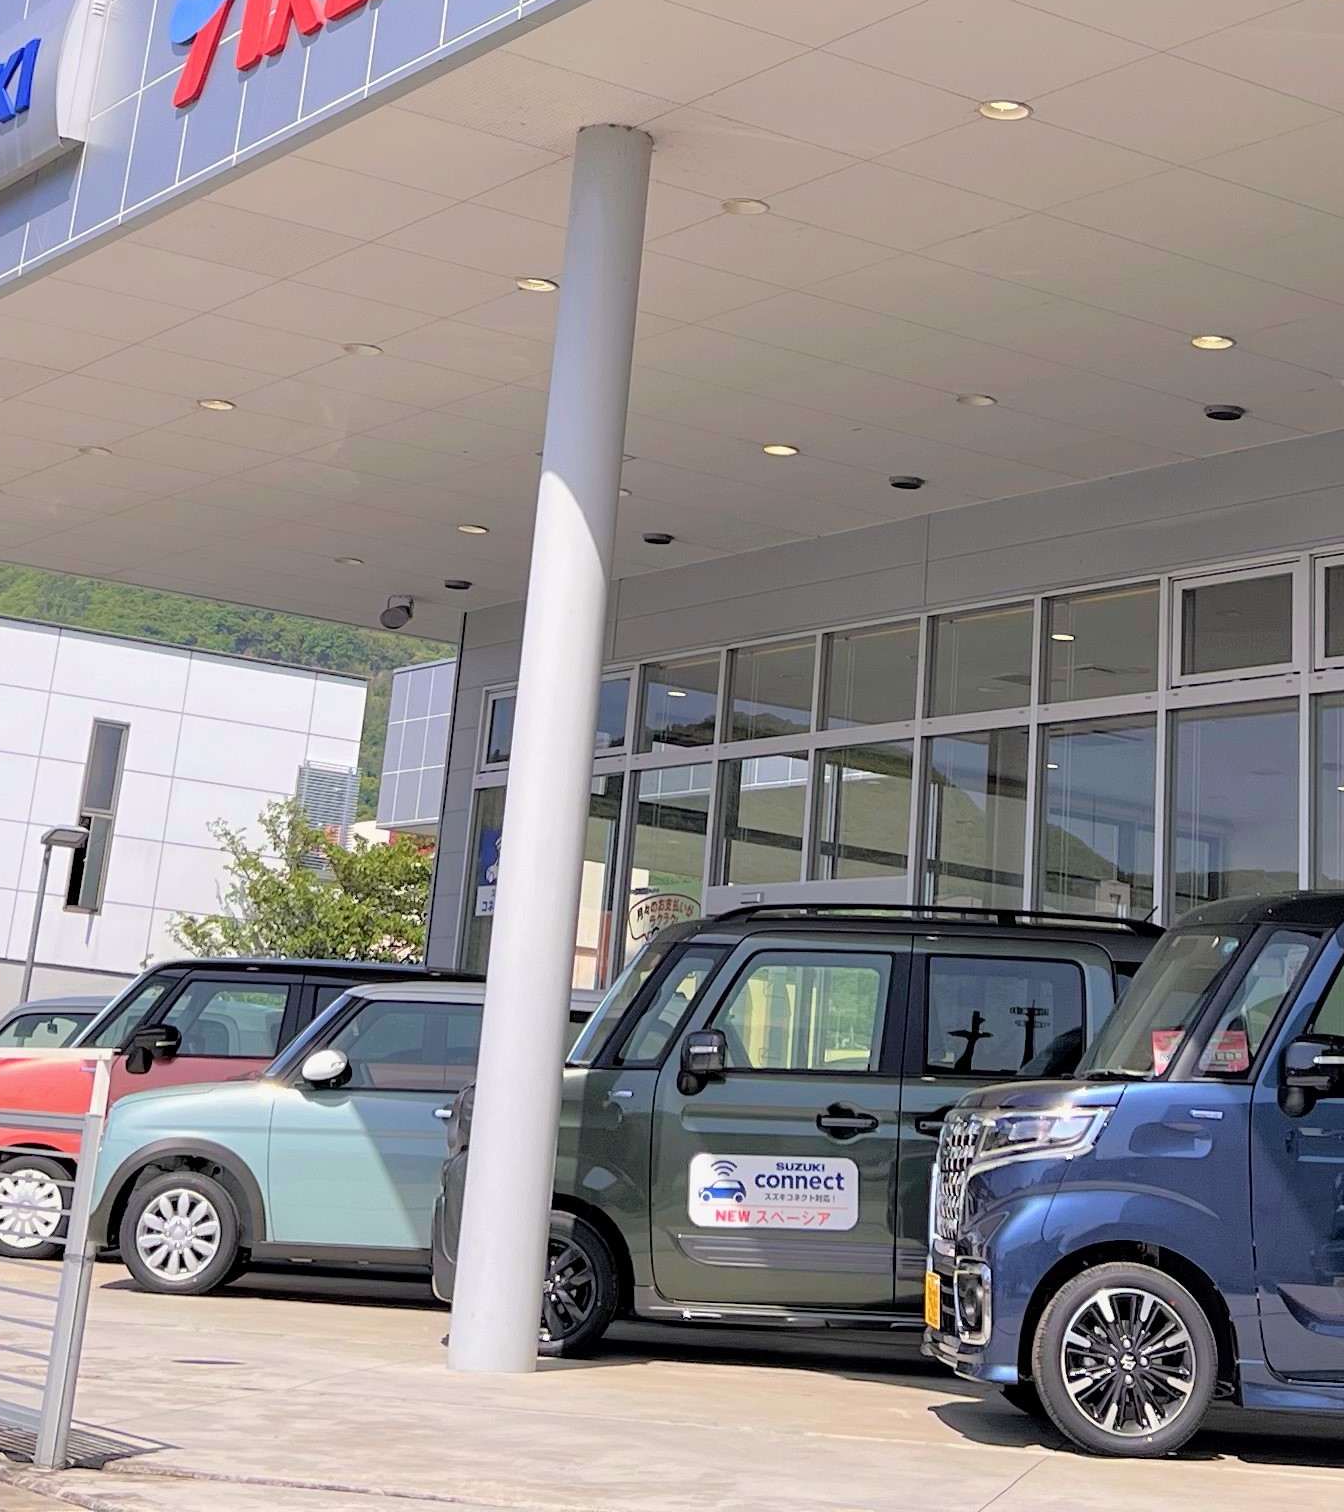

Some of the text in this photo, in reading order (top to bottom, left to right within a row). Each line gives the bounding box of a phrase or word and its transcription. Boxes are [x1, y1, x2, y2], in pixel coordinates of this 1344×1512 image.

[775, 1162, 826, 1172] SUZUKI
[754, 1172, 845, 1191] connect
[715, 1208, 832, 1227] NEW スペーシア
